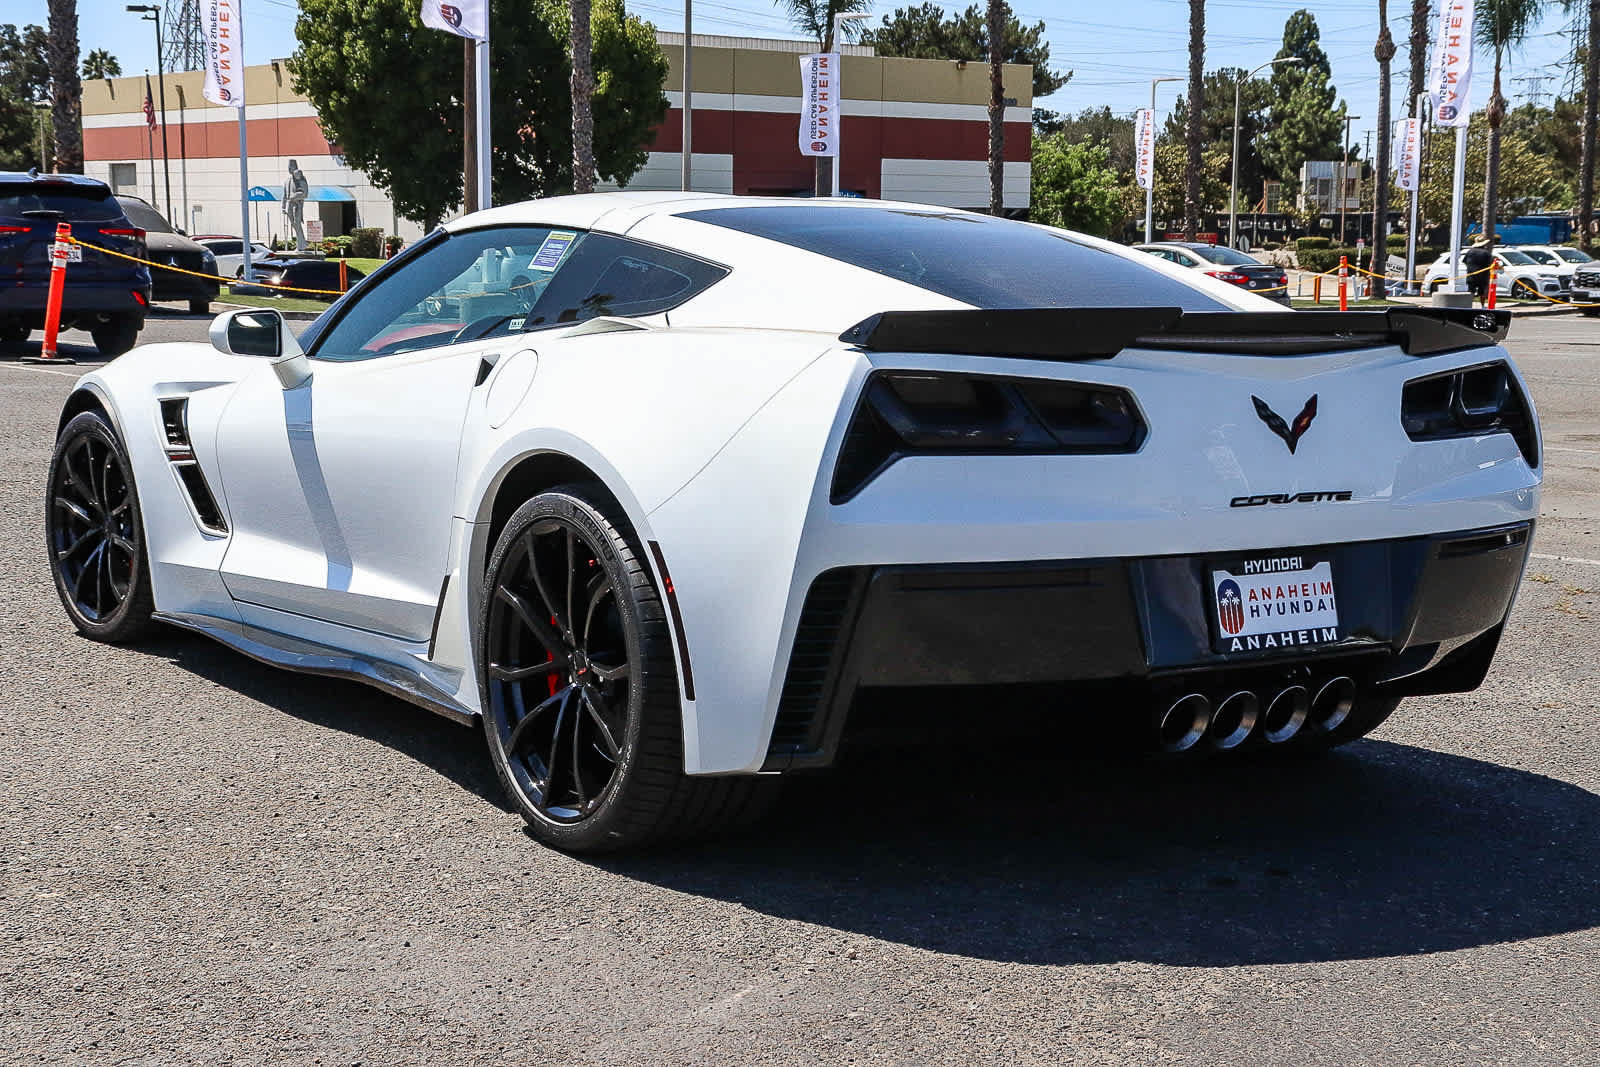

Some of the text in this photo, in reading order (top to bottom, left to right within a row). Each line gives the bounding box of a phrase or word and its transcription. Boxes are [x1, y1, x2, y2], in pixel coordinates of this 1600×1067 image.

[1230, 491, 1352, 507] CORVETTE
[1244, 556, 1303, 574] HYUNDAI
[1248, 581, 1332, 602] ANAHEIM
[1250, 598, 1334, 618] HYUNDAI
[1231, 627, 1337, 652] ANAHEIM
